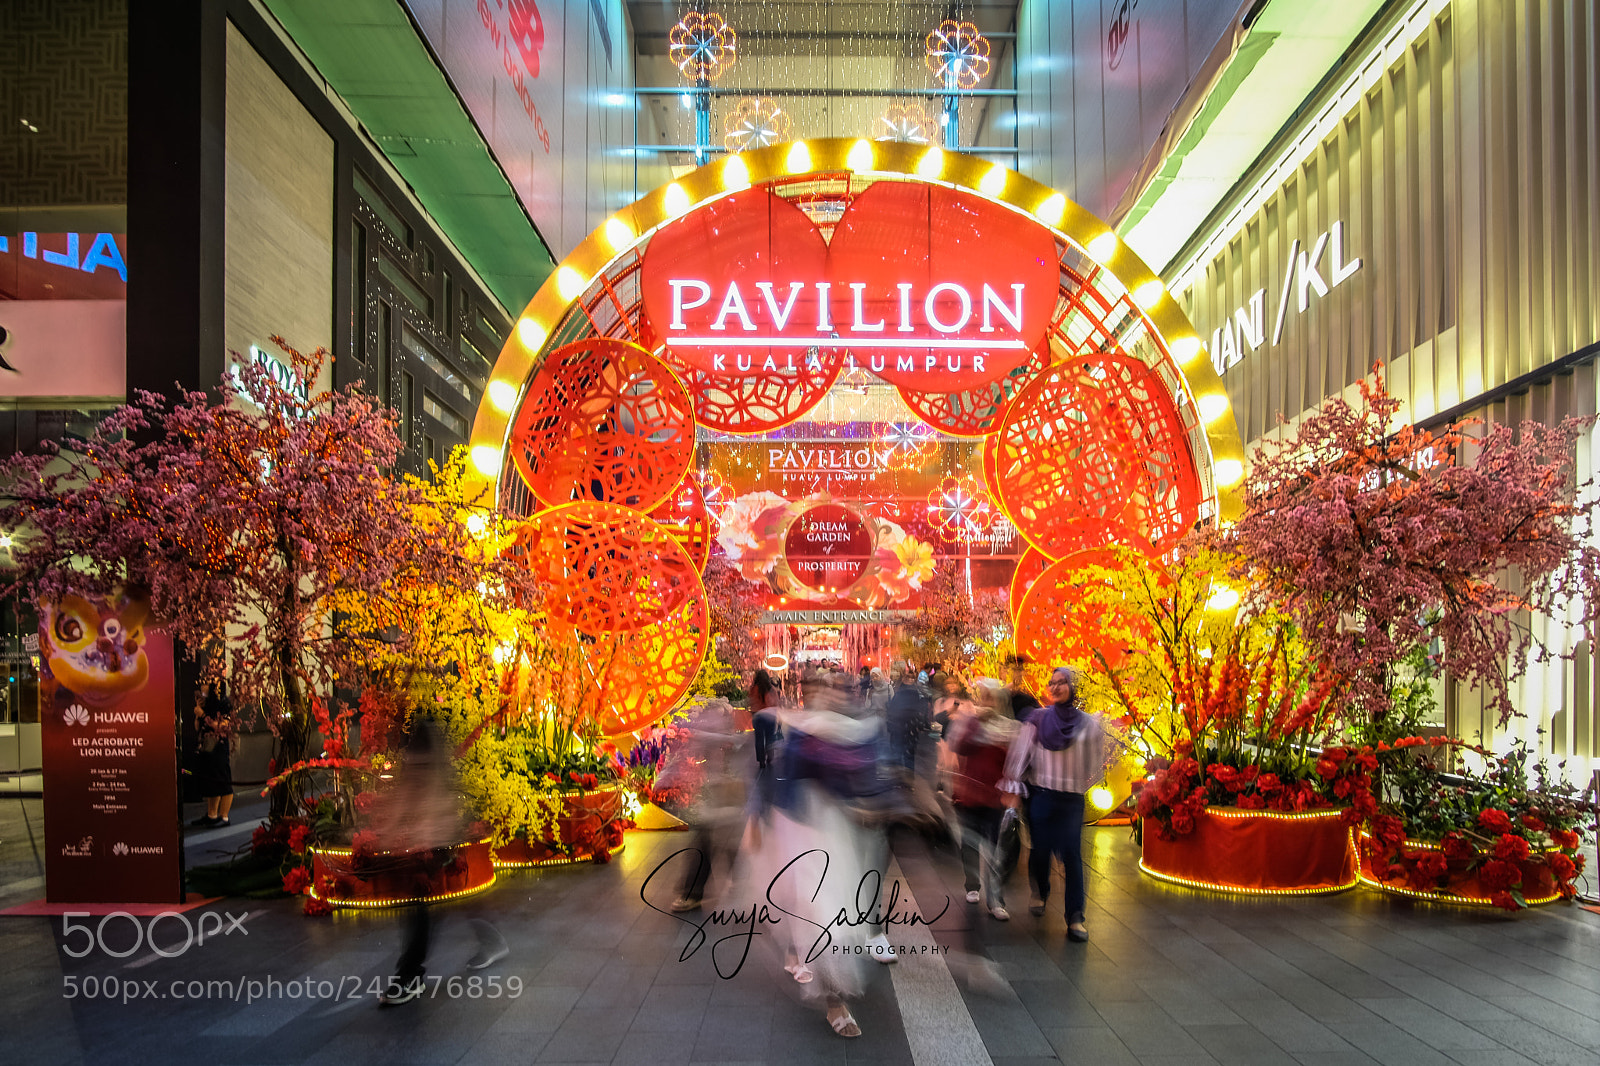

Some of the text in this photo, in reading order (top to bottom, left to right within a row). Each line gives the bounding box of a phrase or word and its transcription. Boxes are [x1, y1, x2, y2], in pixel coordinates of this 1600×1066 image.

[477, 0, 550, 154] ew balance
[668, 279, 1025, 332] PAVILION
[713, 354, 986, 372] KUALA LUMPUR
[768, 449, 889, 468] PAVILION
[783, 473, 821, 481] KUALA
[810, 521, 848, 532] DREAM
[806, 532, 851, 542] GARDEN
[822, 543, 834, 555] of
[798, 561, 861, 572] PROSPERITY
[773, 610, 885, 621] MAIN ENTRANCE
[94, 712, 149, 723] HUAWEI
[73, 738, 144, 746] LED ACROBATIC
[80, 748, 137, 757] LION DANCE
[131, 846, 163, 854] HUAWEI
